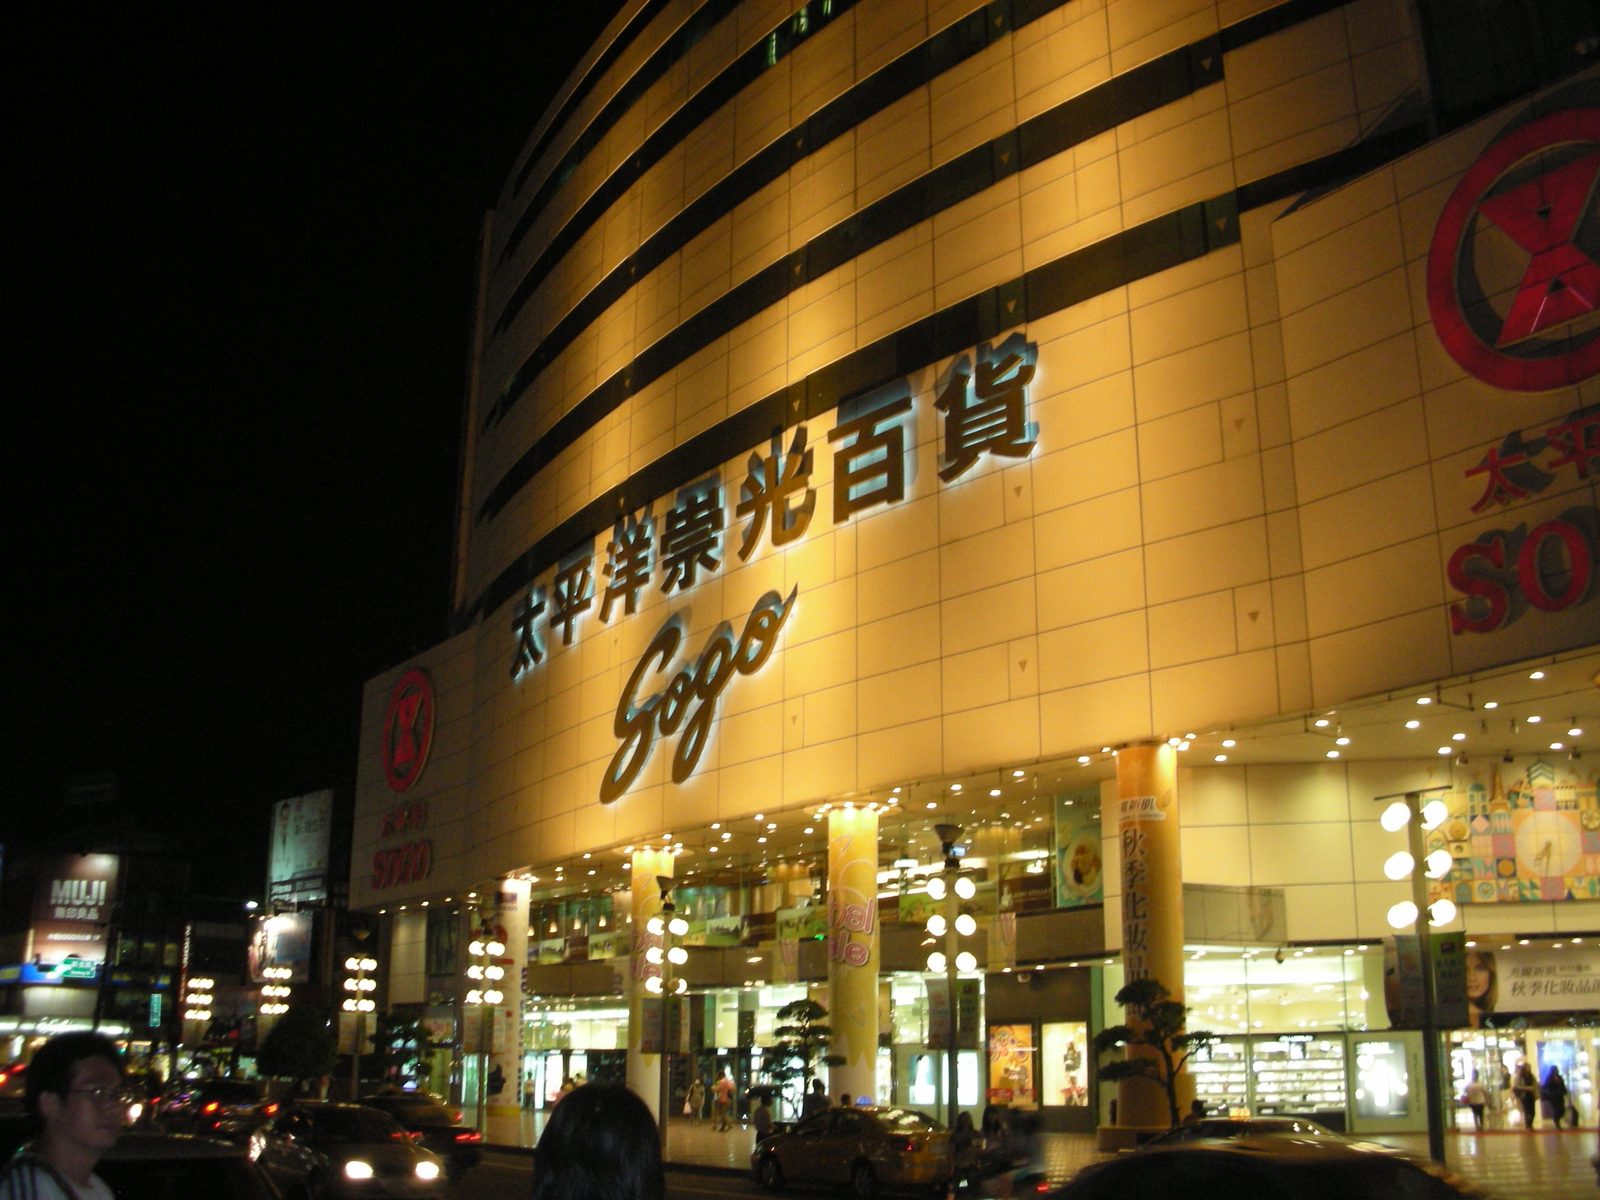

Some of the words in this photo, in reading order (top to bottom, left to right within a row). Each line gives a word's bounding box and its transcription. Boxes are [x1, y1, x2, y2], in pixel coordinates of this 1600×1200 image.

[510, 340, 1037, 678] 太平洋崇光百貨
[1466, 414, 1600, 513] 太平
[1448, 521, 1600, 635] SO
[600, 584, 798, 805] Sogo
[50, 879, 107, 906] MUJI
[371, 841, 431, 890] SOGO
